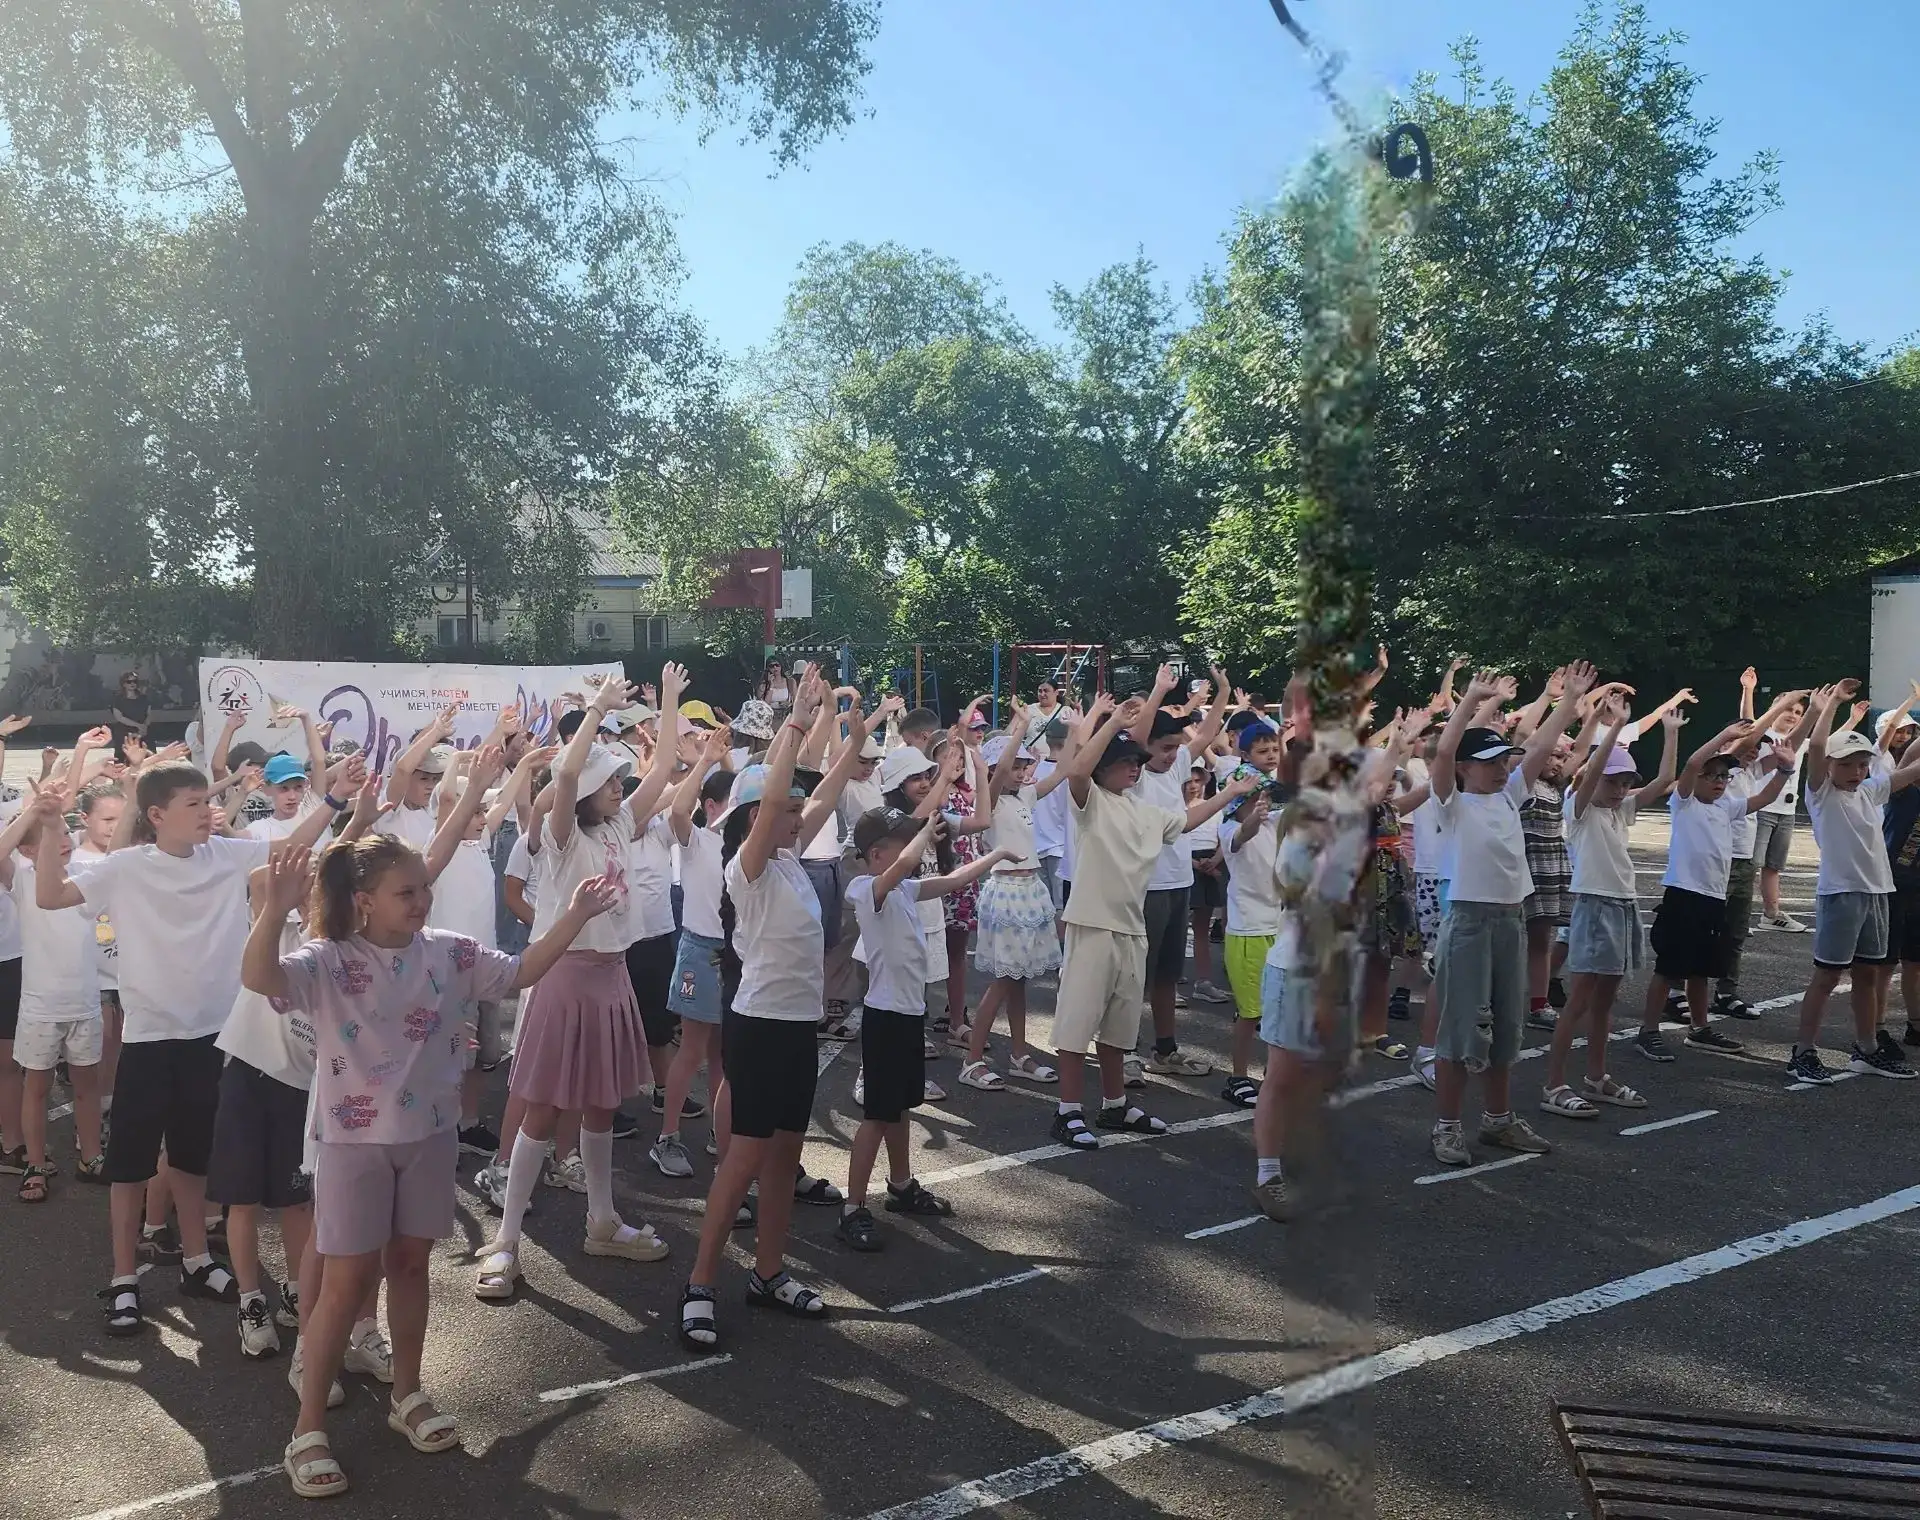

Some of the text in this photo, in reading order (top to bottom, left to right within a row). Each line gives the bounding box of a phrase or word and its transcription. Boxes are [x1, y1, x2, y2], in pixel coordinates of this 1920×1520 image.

[380, 689, 429, 699] УЧИМСЯ,
[229, 699, 241, 709] 17
[680, 981, 696, 996] M
